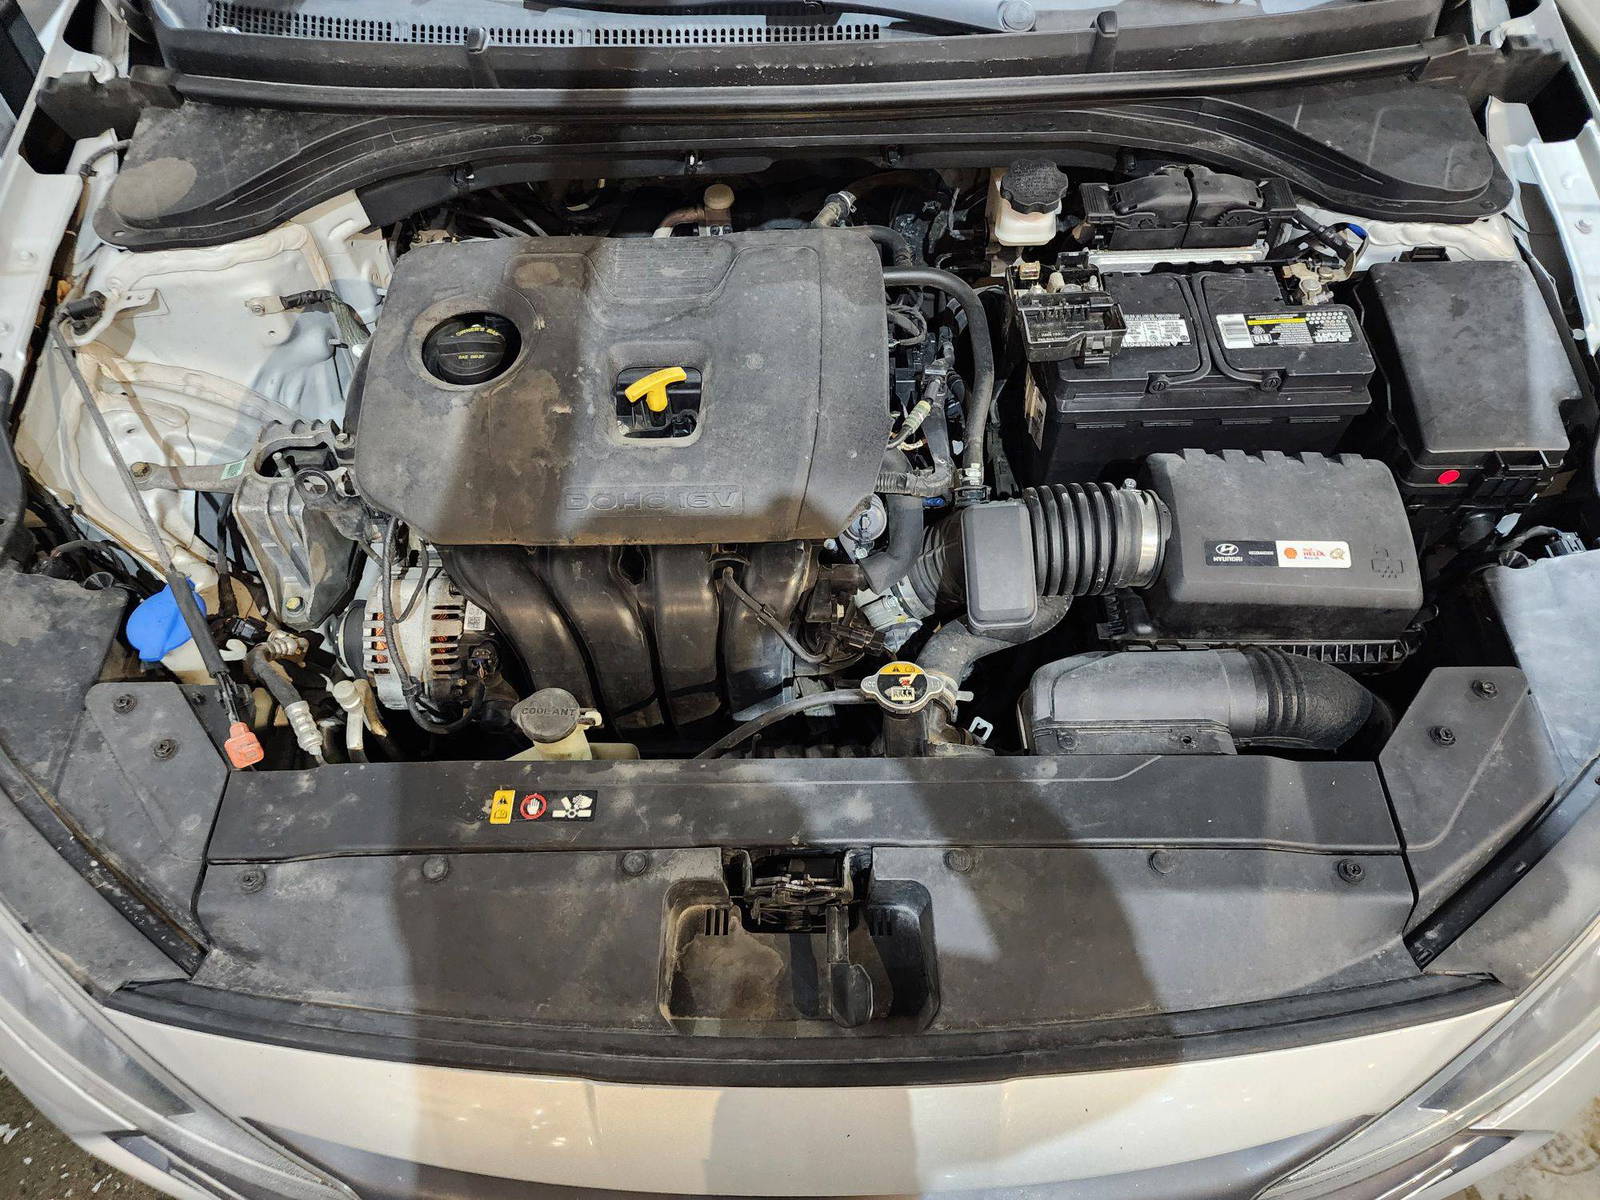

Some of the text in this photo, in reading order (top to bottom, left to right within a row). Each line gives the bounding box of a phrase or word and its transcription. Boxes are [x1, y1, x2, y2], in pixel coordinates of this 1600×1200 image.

[565, 489, 738, 511] DOHC 16V
[521, 707, 576, 716] COOLANT
